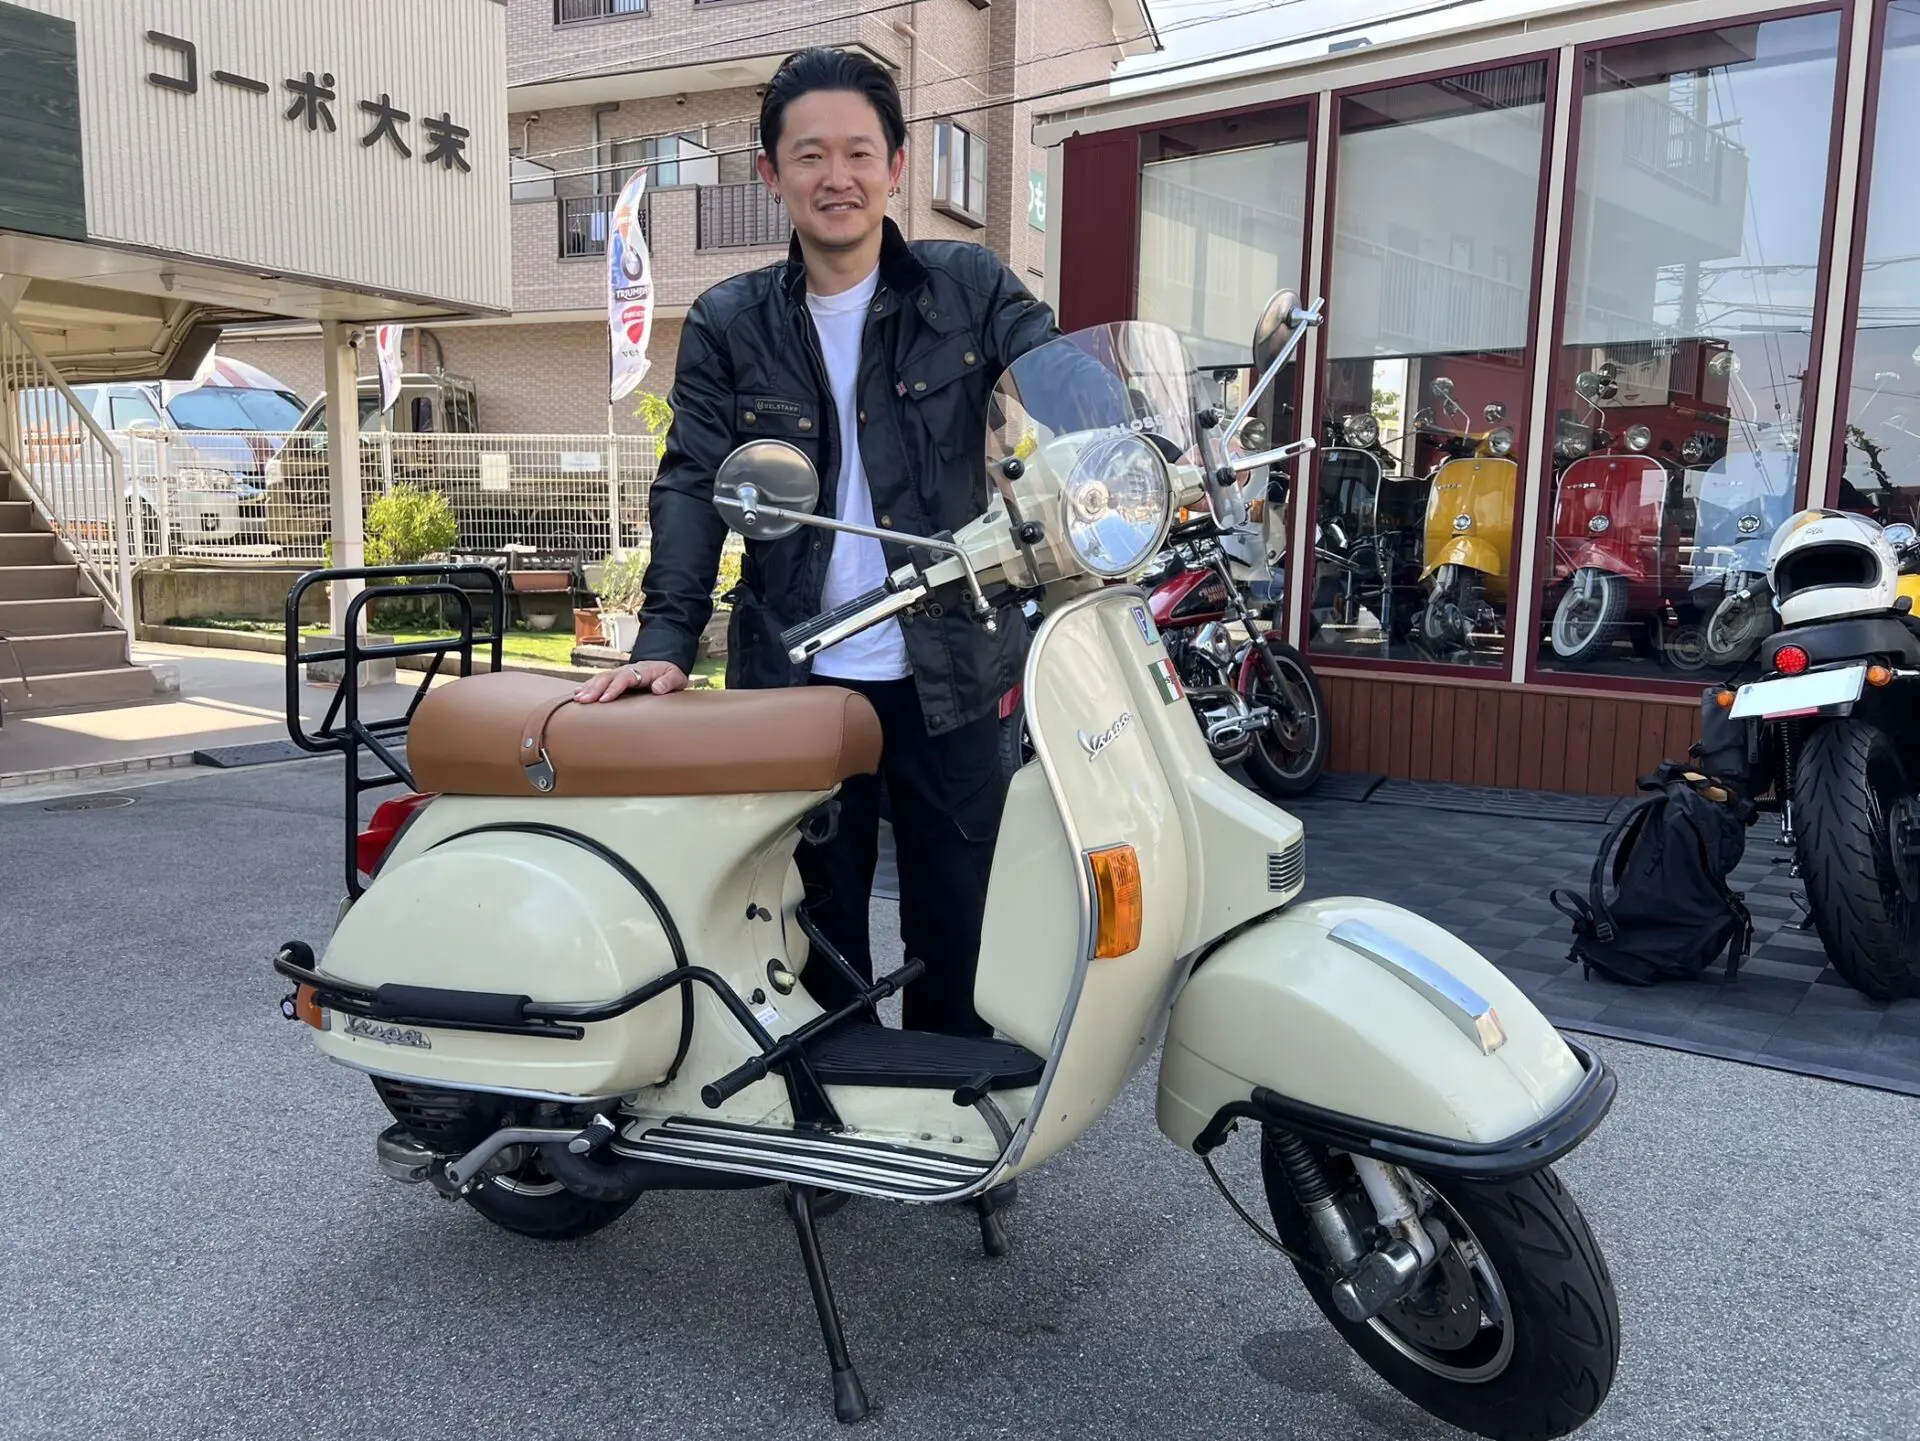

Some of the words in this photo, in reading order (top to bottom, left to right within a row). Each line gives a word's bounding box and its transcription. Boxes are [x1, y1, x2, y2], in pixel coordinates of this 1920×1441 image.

[145, 30, 471, 173] コーポ大末
[1077, 712, 1132, 762] Vespa
